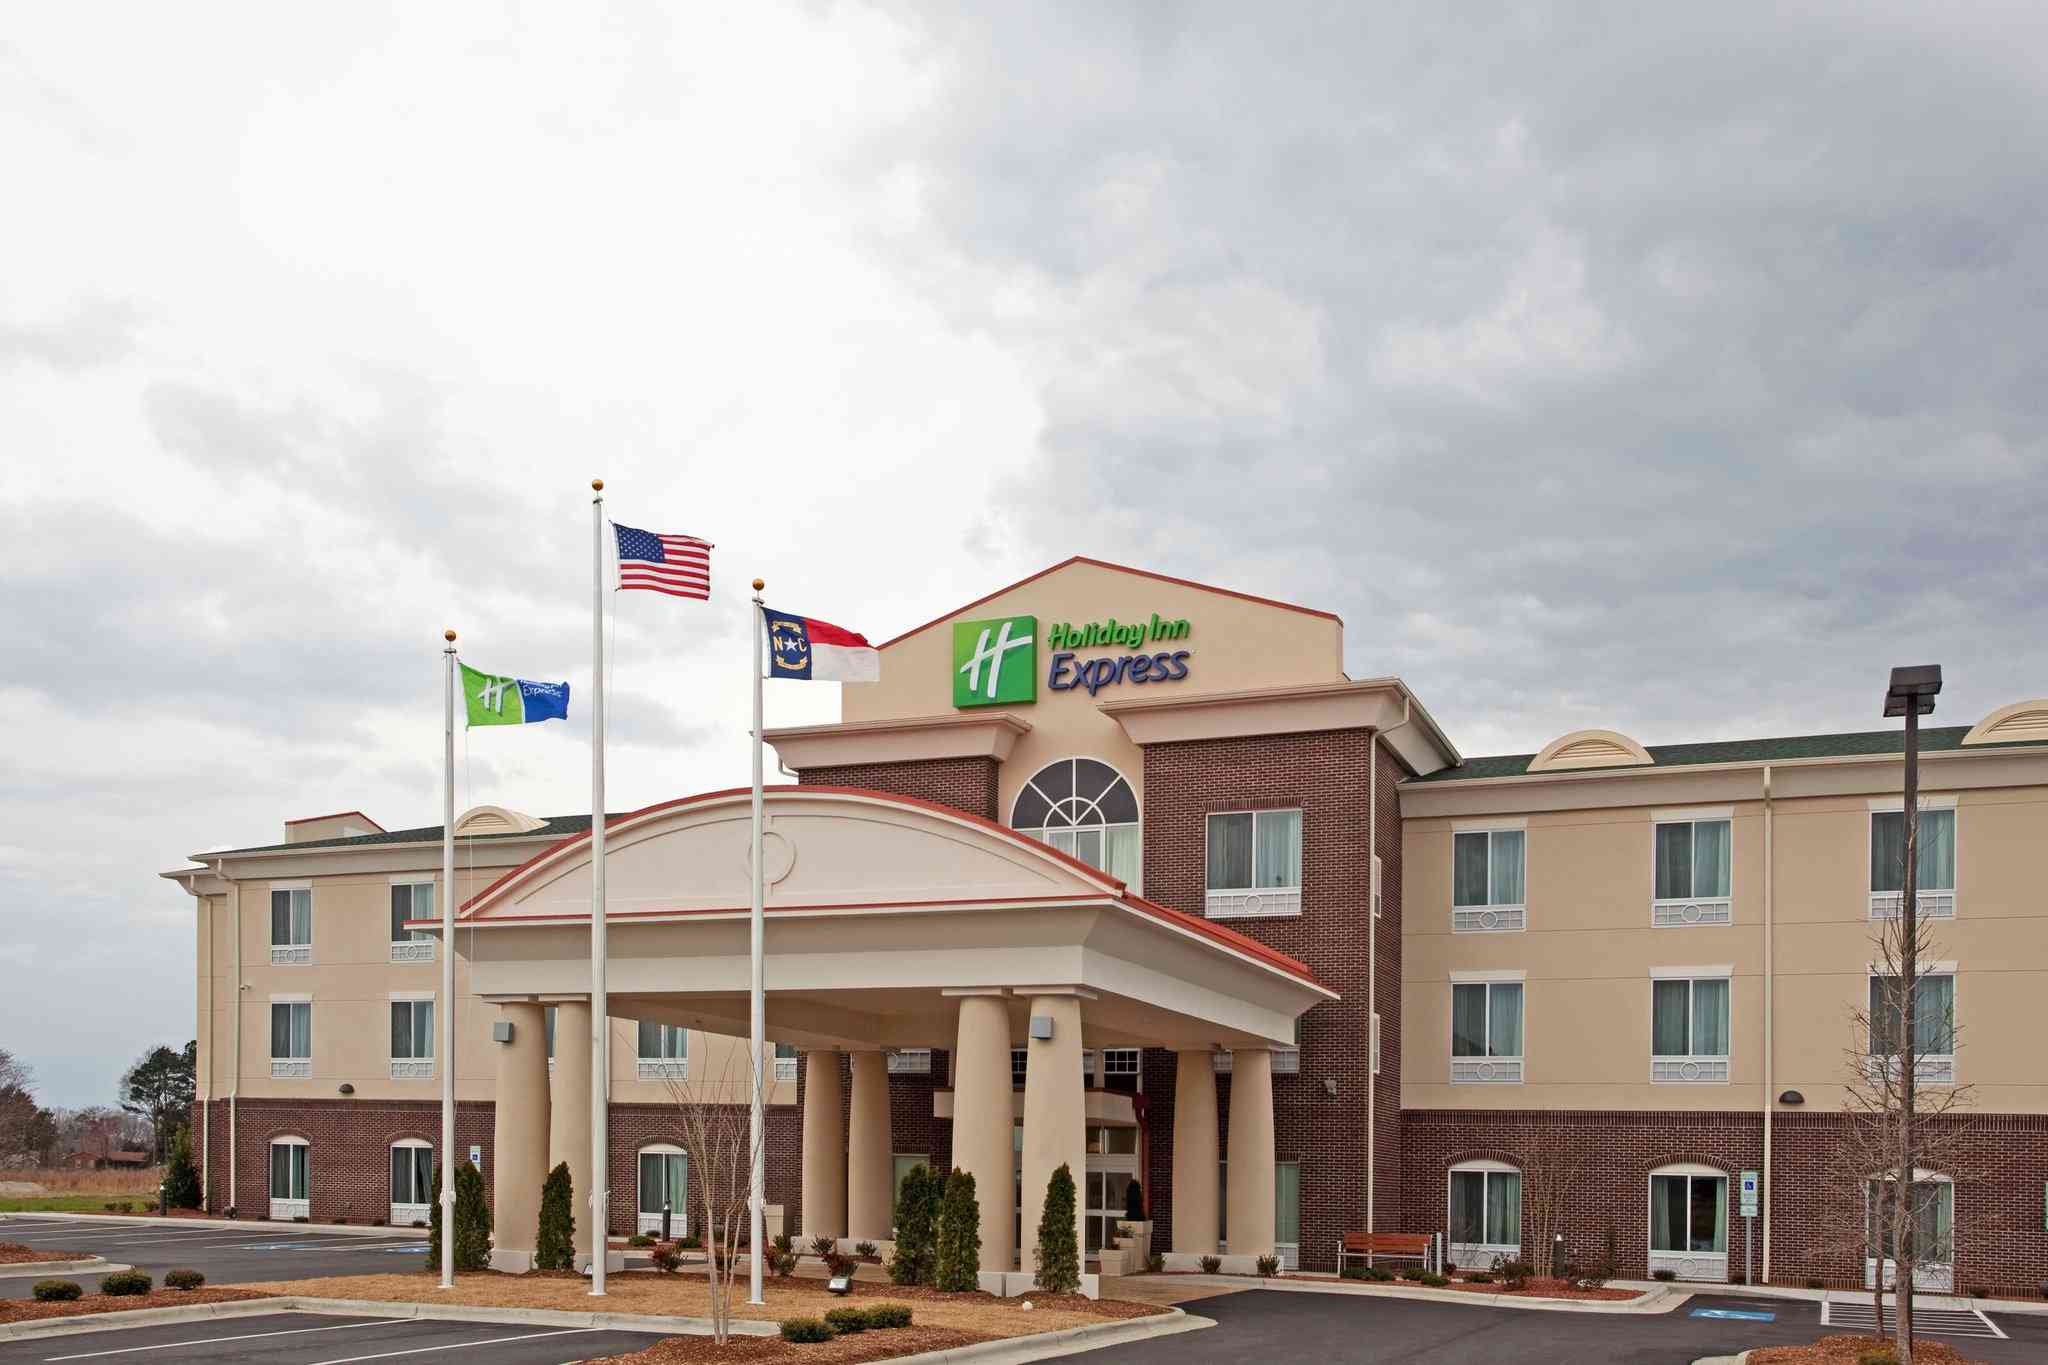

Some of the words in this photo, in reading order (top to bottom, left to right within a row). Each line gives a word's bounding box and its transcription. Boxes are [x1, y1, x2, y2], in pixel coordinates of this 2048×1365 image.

[1048, 618, 1146, 650] Holiday
[1149, 612, 1191, 641] Inn
[1047, 650, 1191, 697] Express
